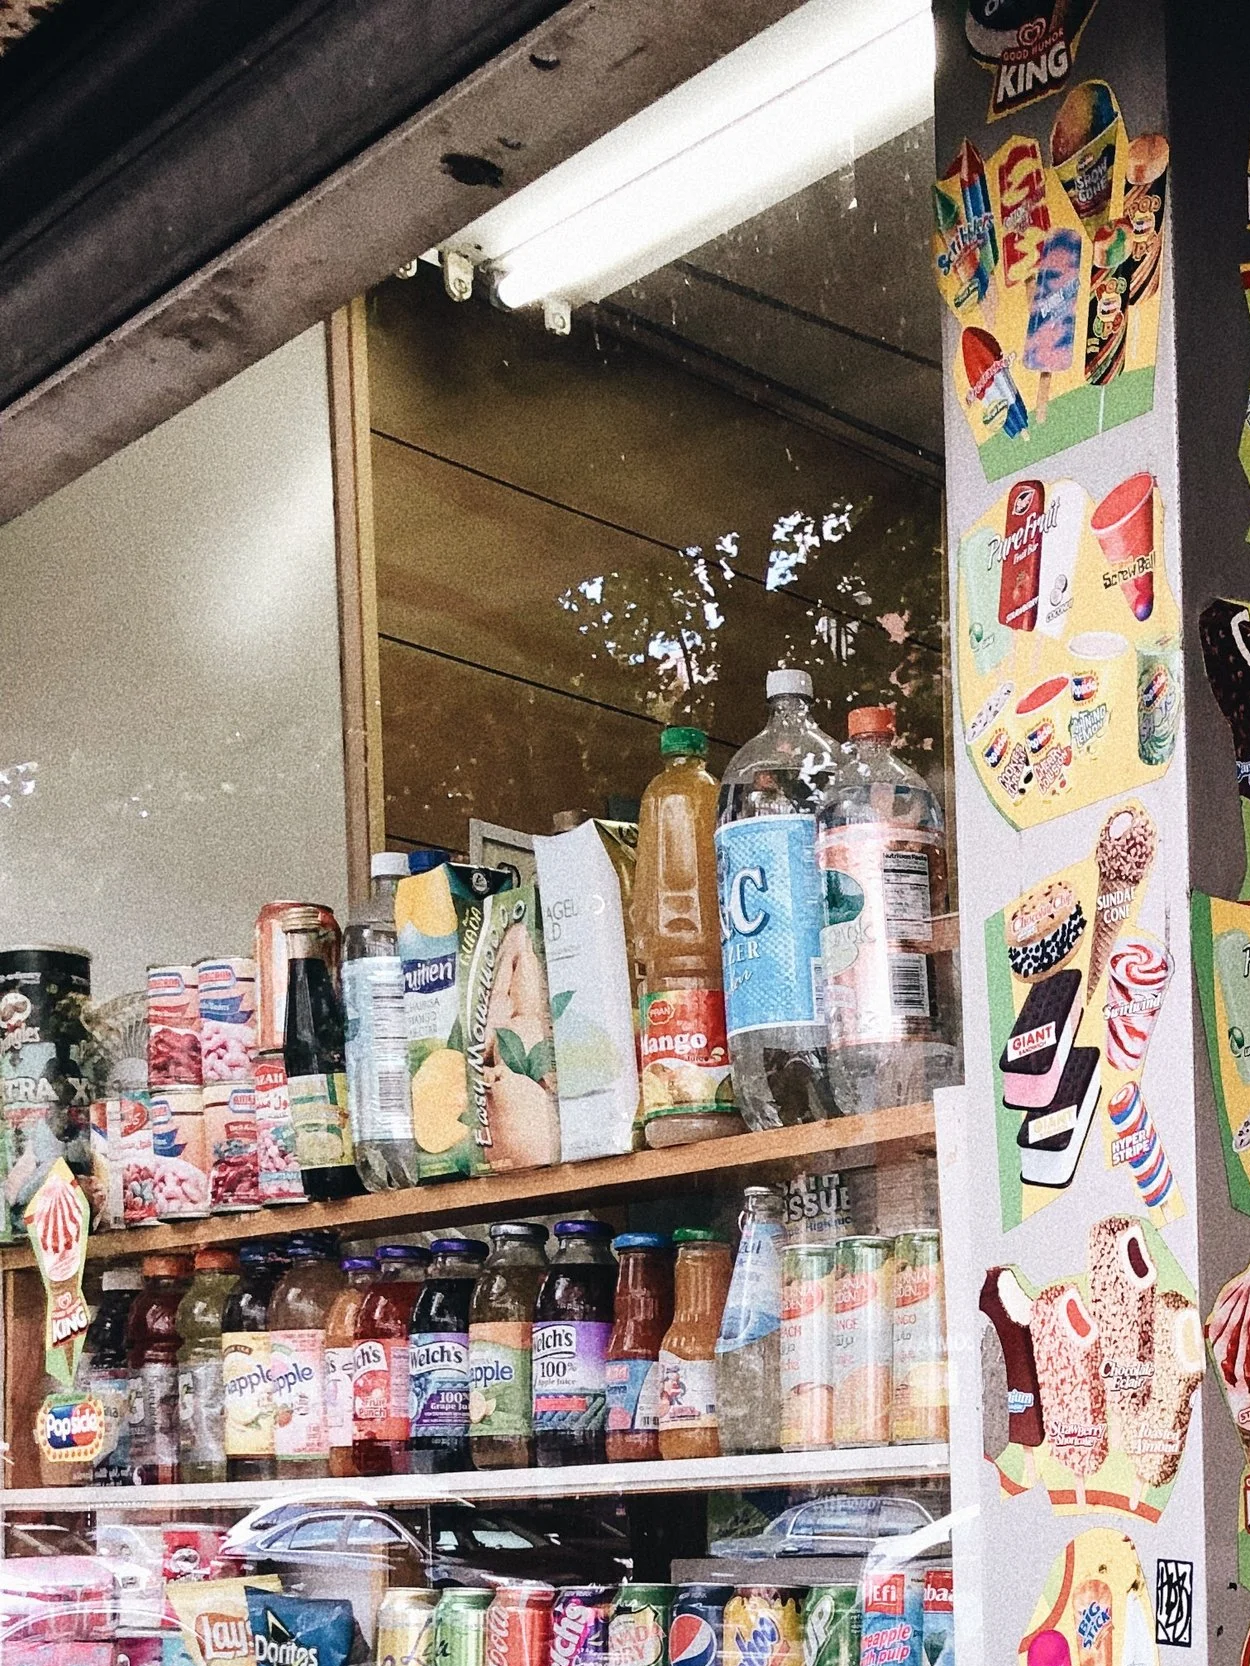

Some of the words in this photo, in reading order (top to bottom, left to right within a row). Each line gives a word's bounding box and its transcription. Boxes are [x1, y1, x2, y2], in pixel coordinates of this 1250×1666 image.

[996, 43, 1070, 104] KING
[1097, 887, 1136, 911] SUNDAE
[1103, 906, 1131, 924] CONE
[648, 1002, 672, 1020] PRAN
[1012, 1026, 1053, 1051] GIANT
[470, 1076, 494, 1148] Easy
[1112, 1129, 1148, 1153] HYPER
[1112, 1142, 1152, 1166] STRIPE
[51, 1305, 88, 1341] KING
[410, 1348, 464, 1373] Welch's
[539, 1360, 577, 1379] 100%
[45, 1408, 97, 1447] Popsicle
[877, 1644, 911, 1666] pulp
